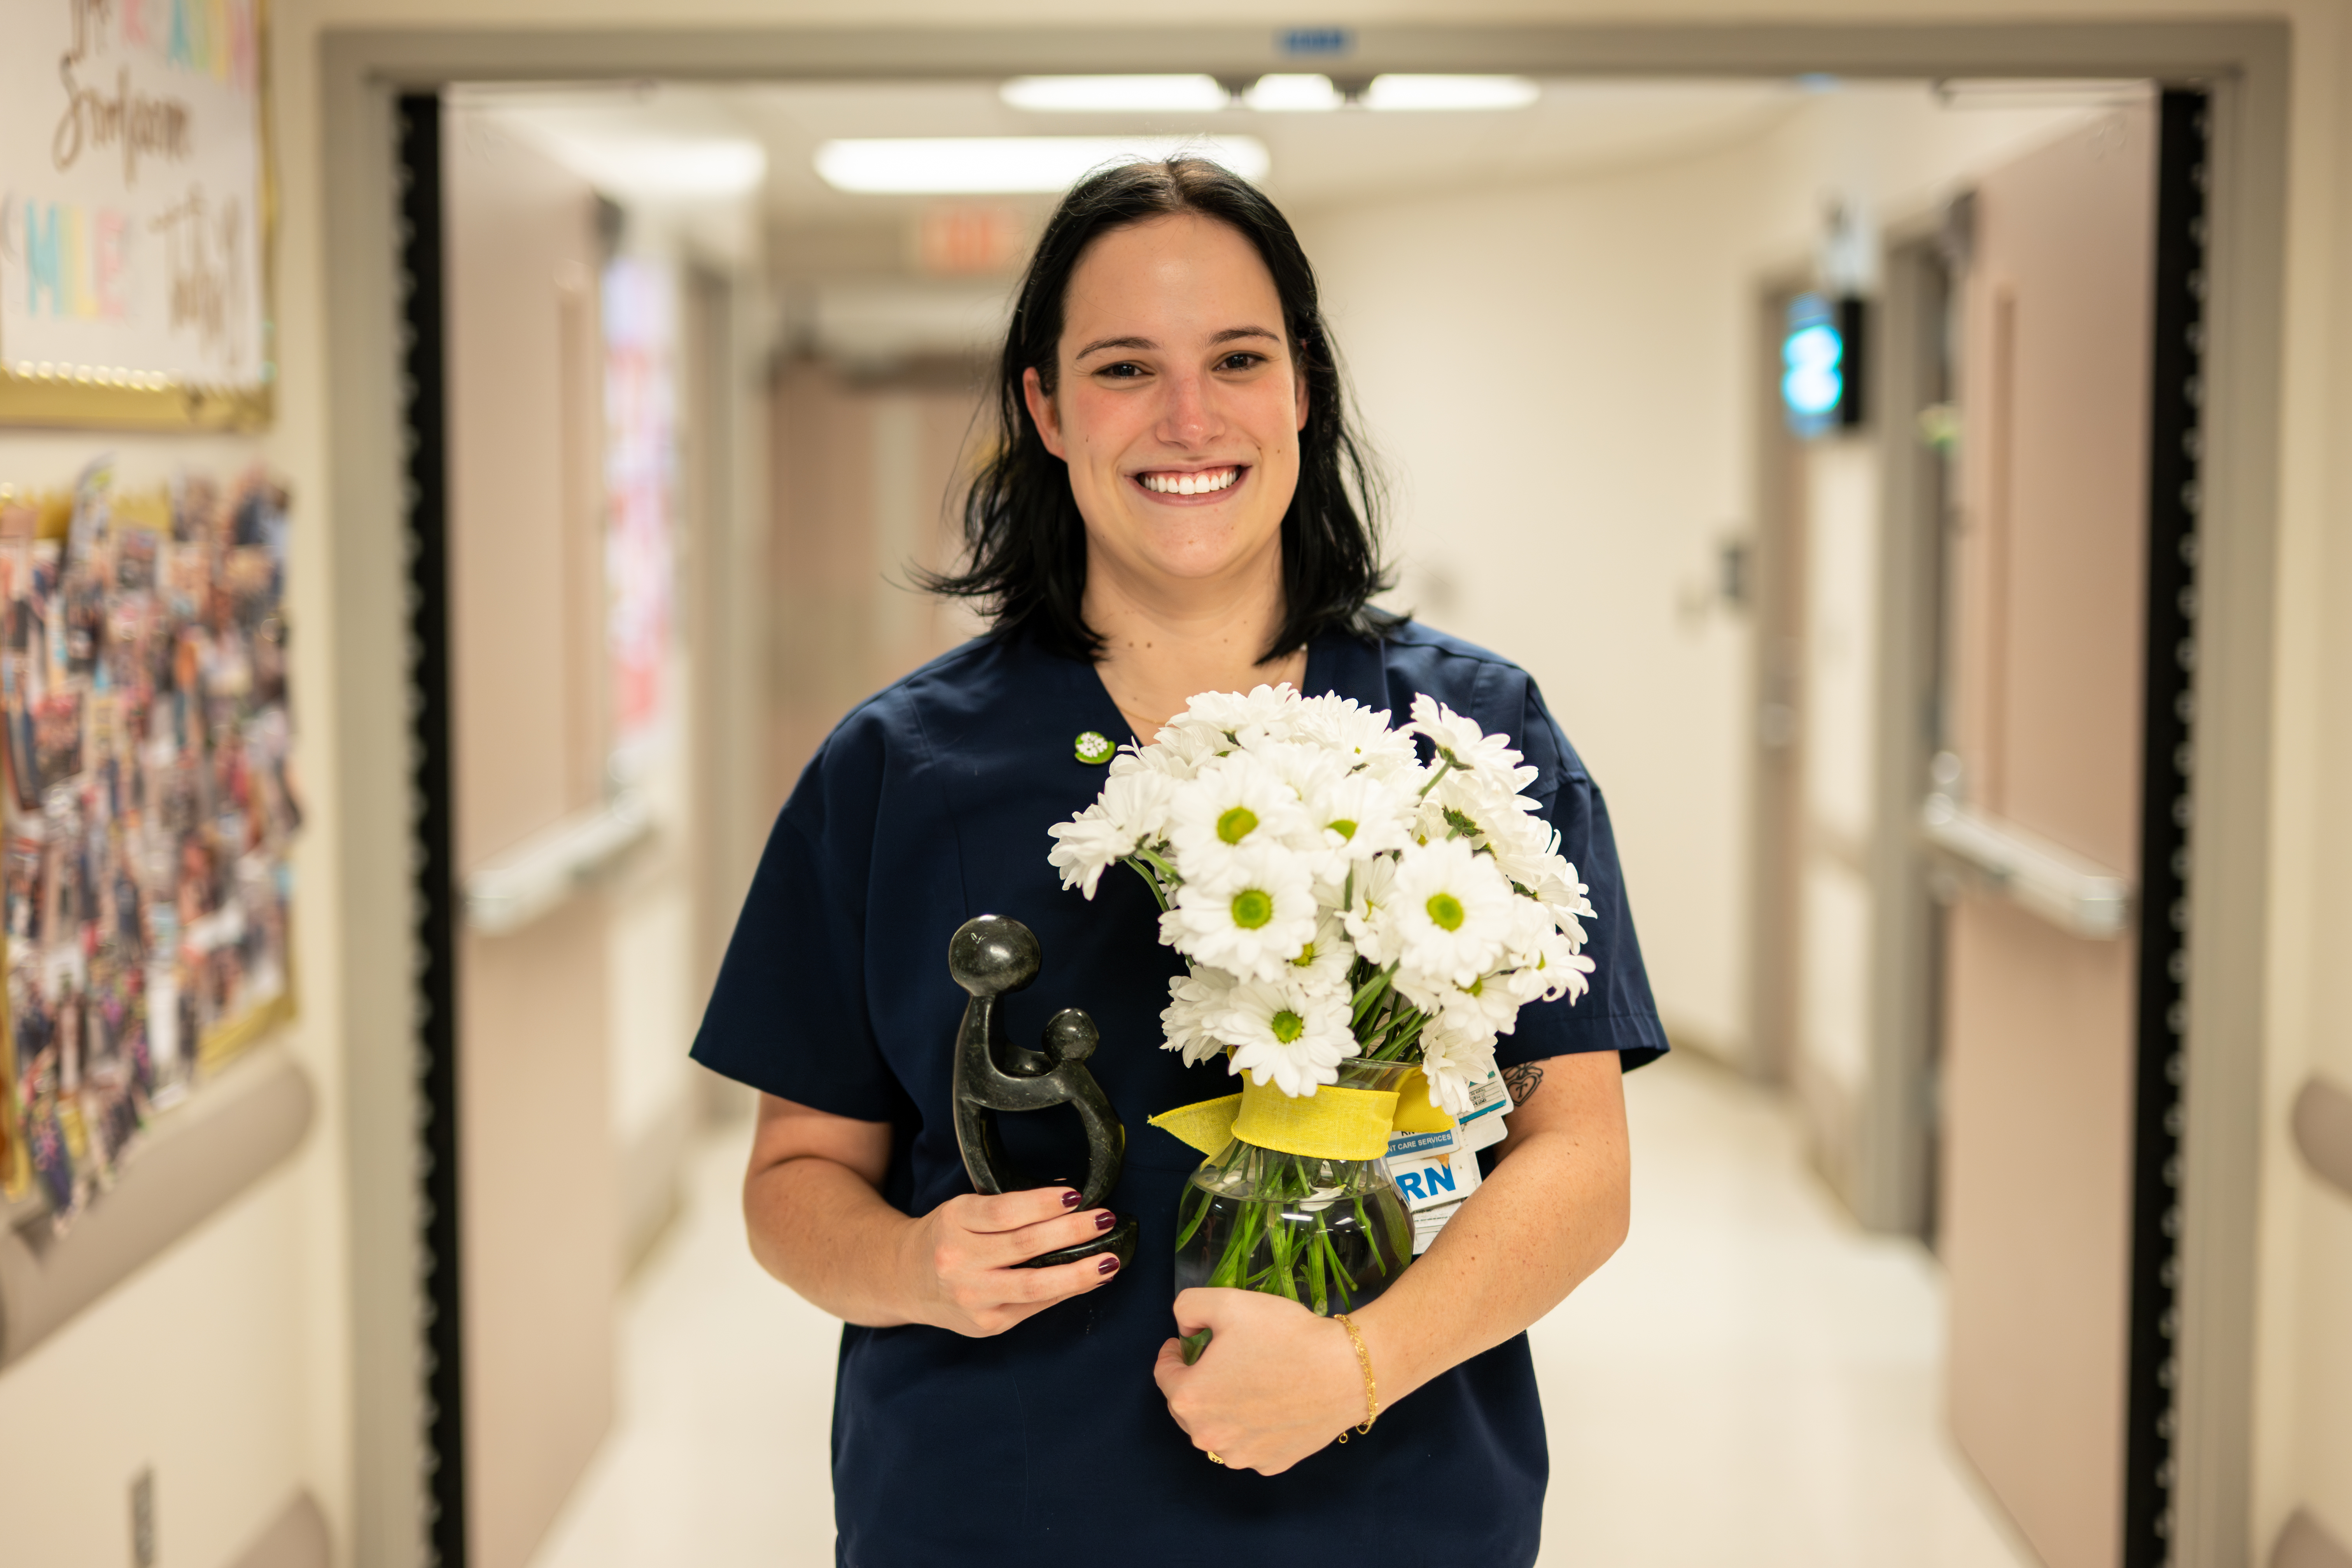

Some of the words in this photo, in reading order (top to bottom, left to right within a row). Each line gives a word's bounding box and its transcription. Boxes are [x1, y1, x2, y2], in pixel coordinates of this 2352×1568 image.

[1398, 1141, 1416, 1150] CARE
[1418, 1134, 1451, 1146] SERVICES
[1395, 1163, 1456, 1202] RN
